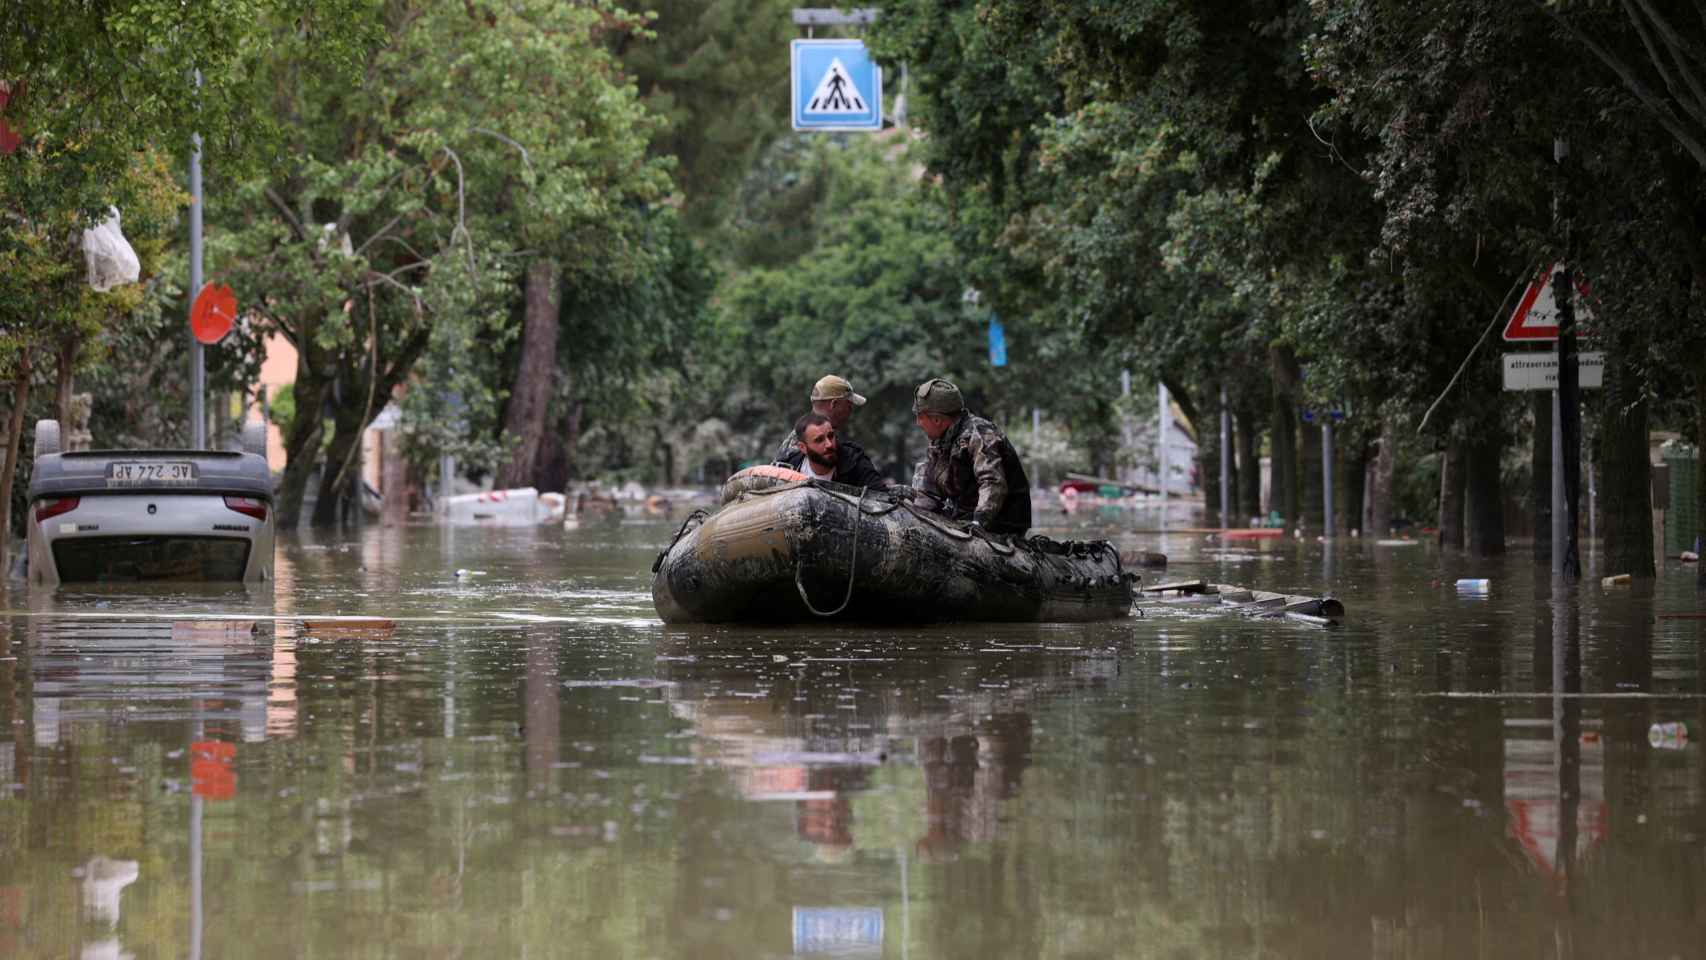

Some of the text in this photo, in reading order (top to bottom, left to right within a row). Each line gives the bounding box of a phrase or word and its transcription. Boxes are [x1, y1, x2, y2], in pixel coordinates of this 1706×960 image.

[1510, 359, 1558, 369] attraversam
[115, 465, 133, 479] AP
[171, 465, 189, 479] AC
